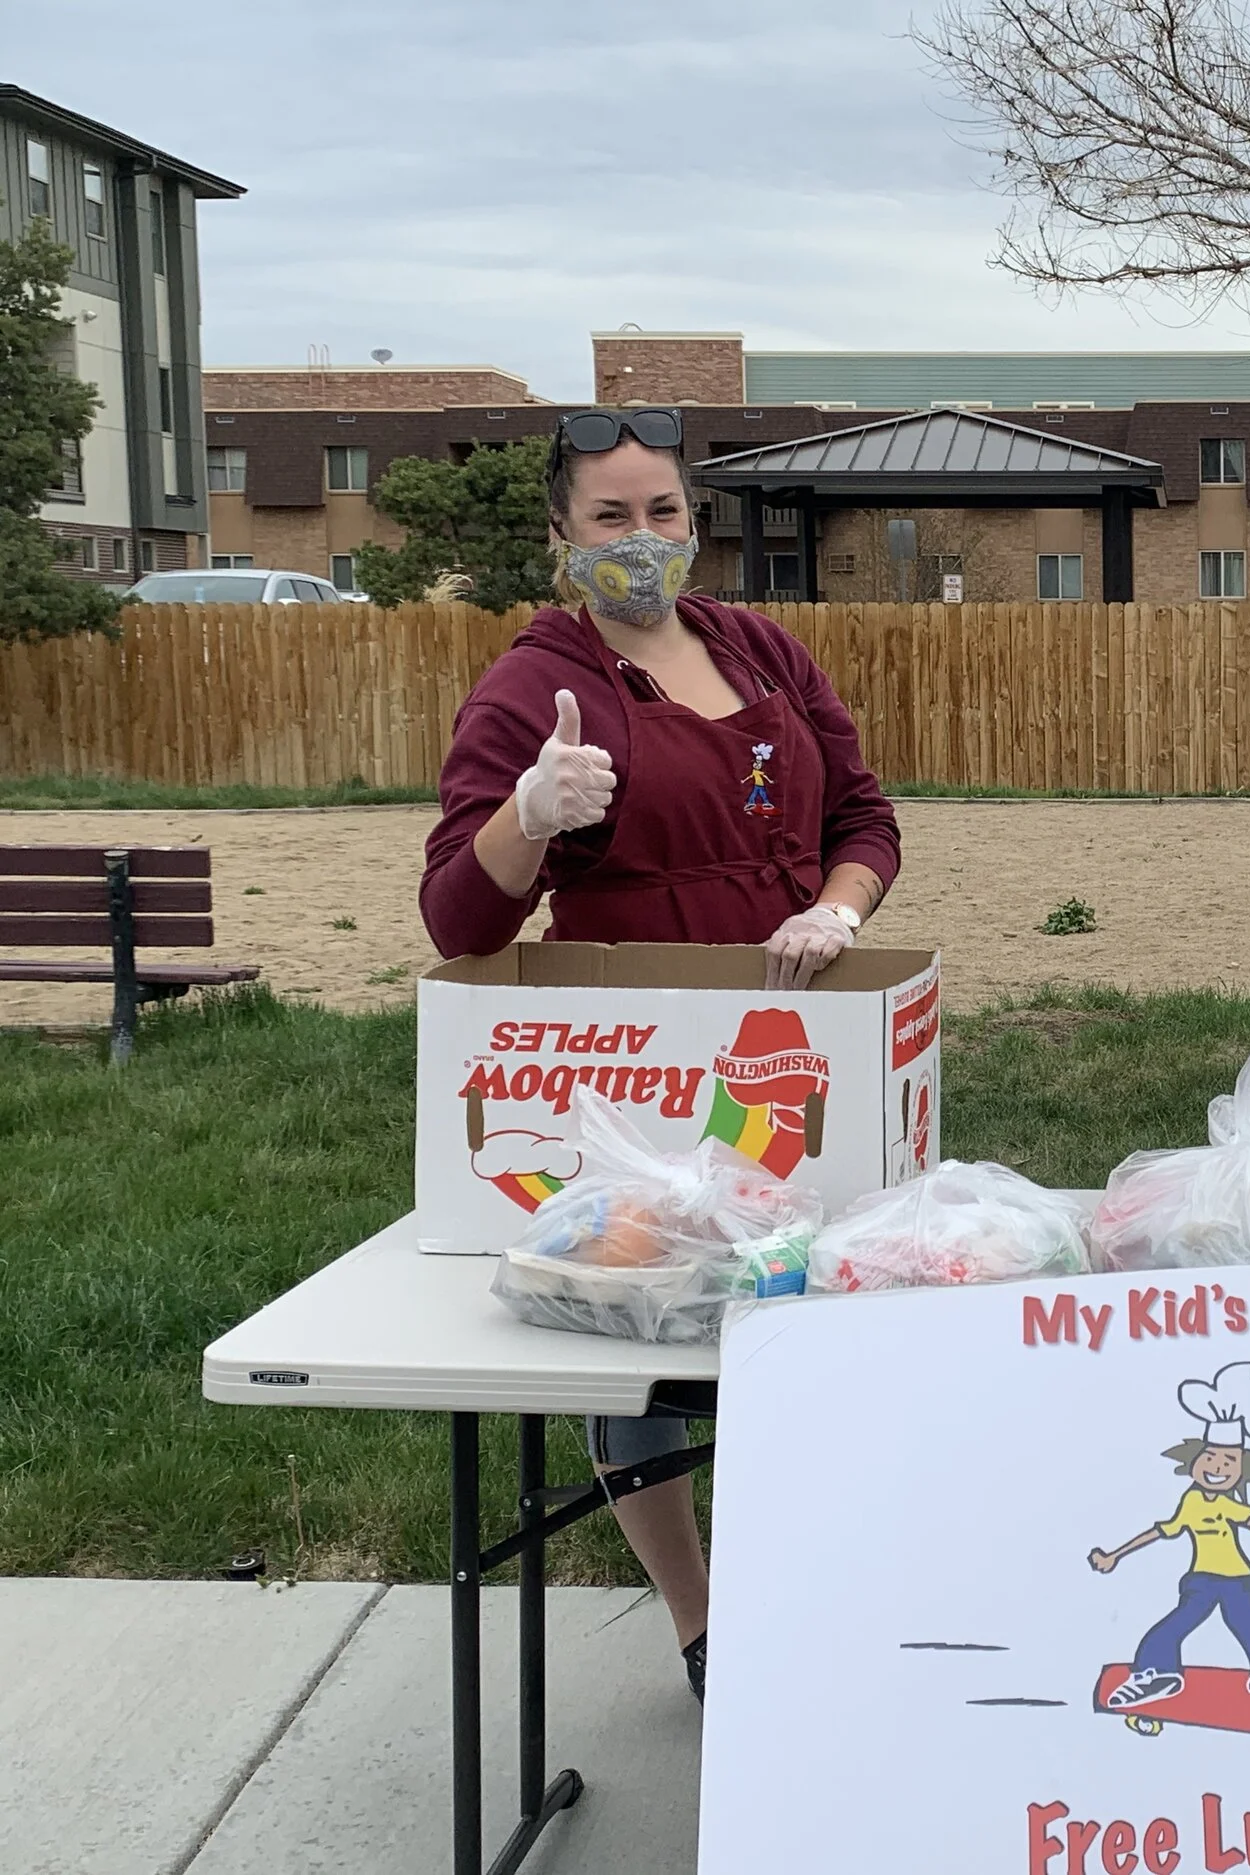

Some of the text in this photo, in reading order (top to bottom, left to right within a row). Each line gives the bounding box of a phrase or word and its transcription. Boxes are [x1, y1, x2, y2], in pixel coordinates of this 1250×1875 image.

[490, 1021, 658, 1054] APPLES
[458, 1063, 706, 1118] Rainbow
[713, 1055, 830, 1080] WASHINGTON
[1022, 1293, 1113, 1351] My
[1128, 1283, 1249, 1339] Kid's
[1027, 1800, 1182, 1875] Free
